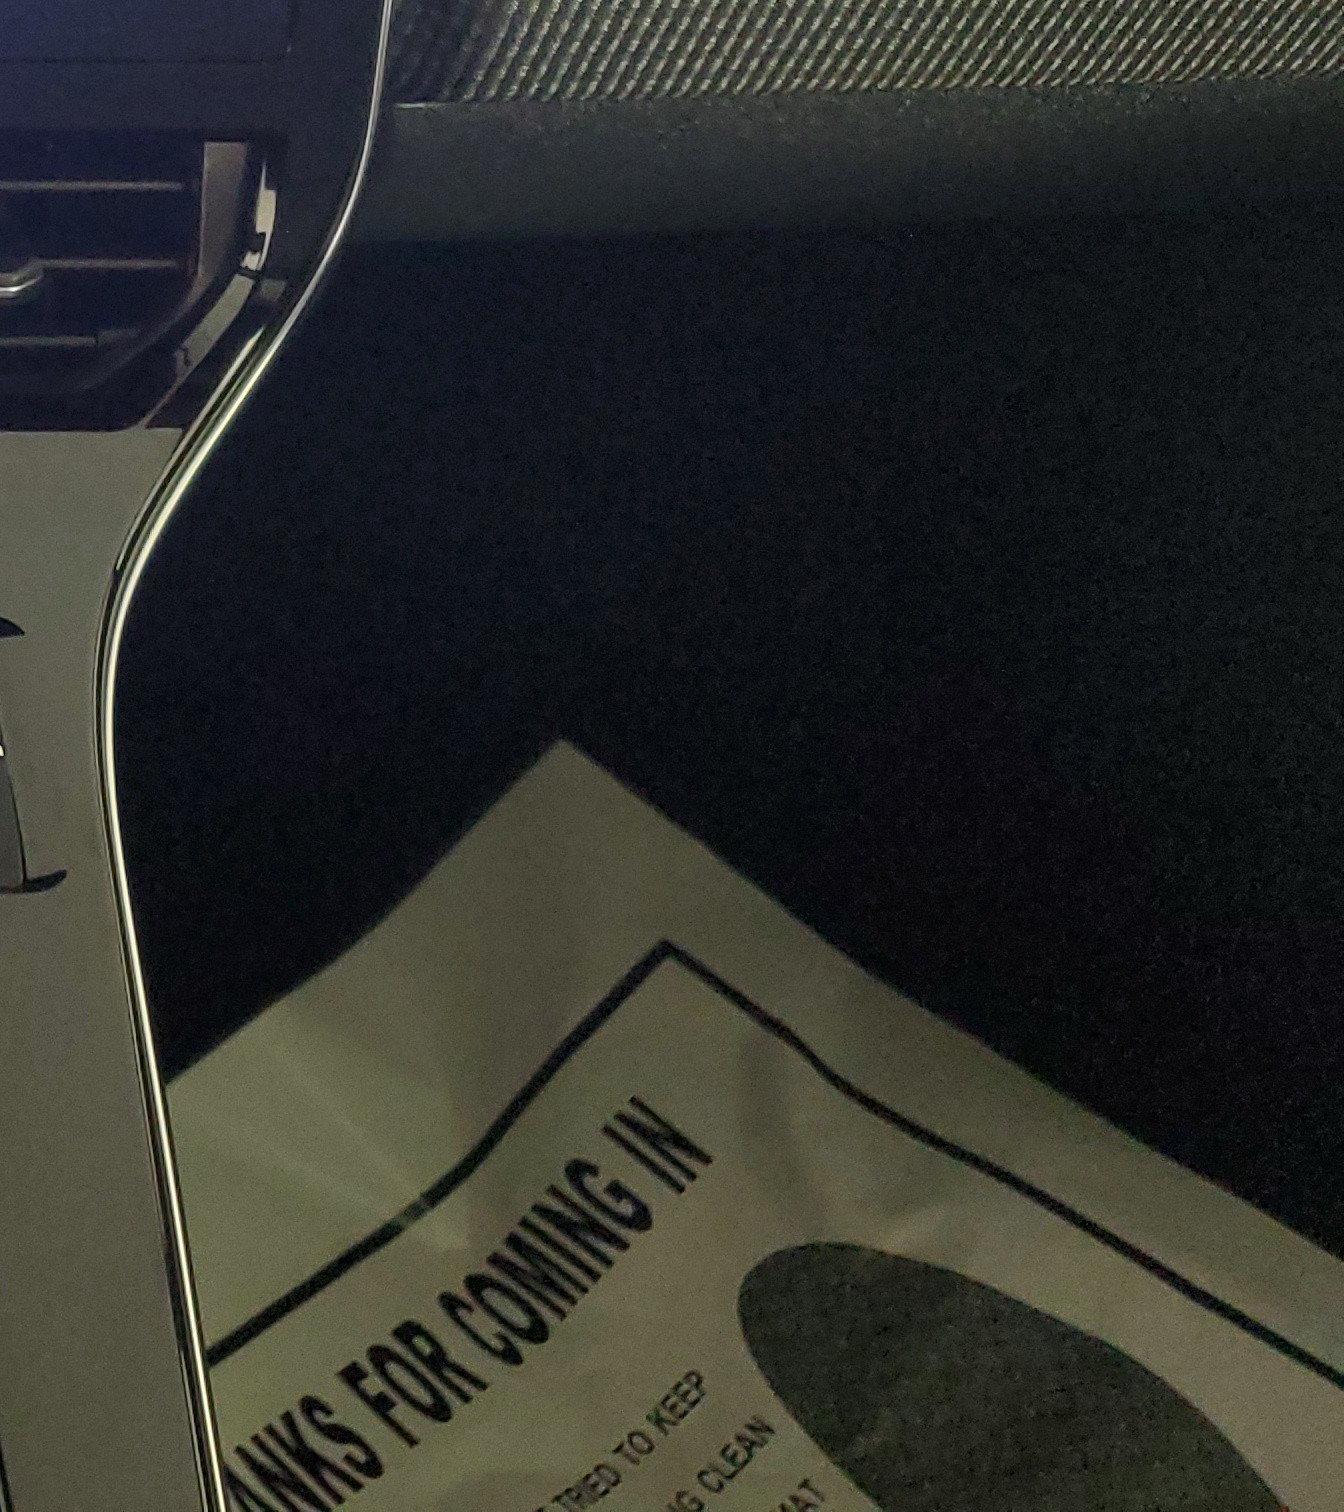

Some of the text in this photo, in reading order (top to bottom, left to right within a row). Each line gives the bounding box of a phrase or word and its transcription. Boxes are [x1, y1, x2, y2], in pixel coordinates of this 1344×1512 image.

[336, 1319, 489, 1448] FOR
[436, 1157, 654, 1366] COMING
[602, 1096, 713, 1195] IN
[613, 1430, 655, 1465] TO
[645, 1370, 706, 1436] KEEP
[697, 1414, 775, 1494] CLEAN
